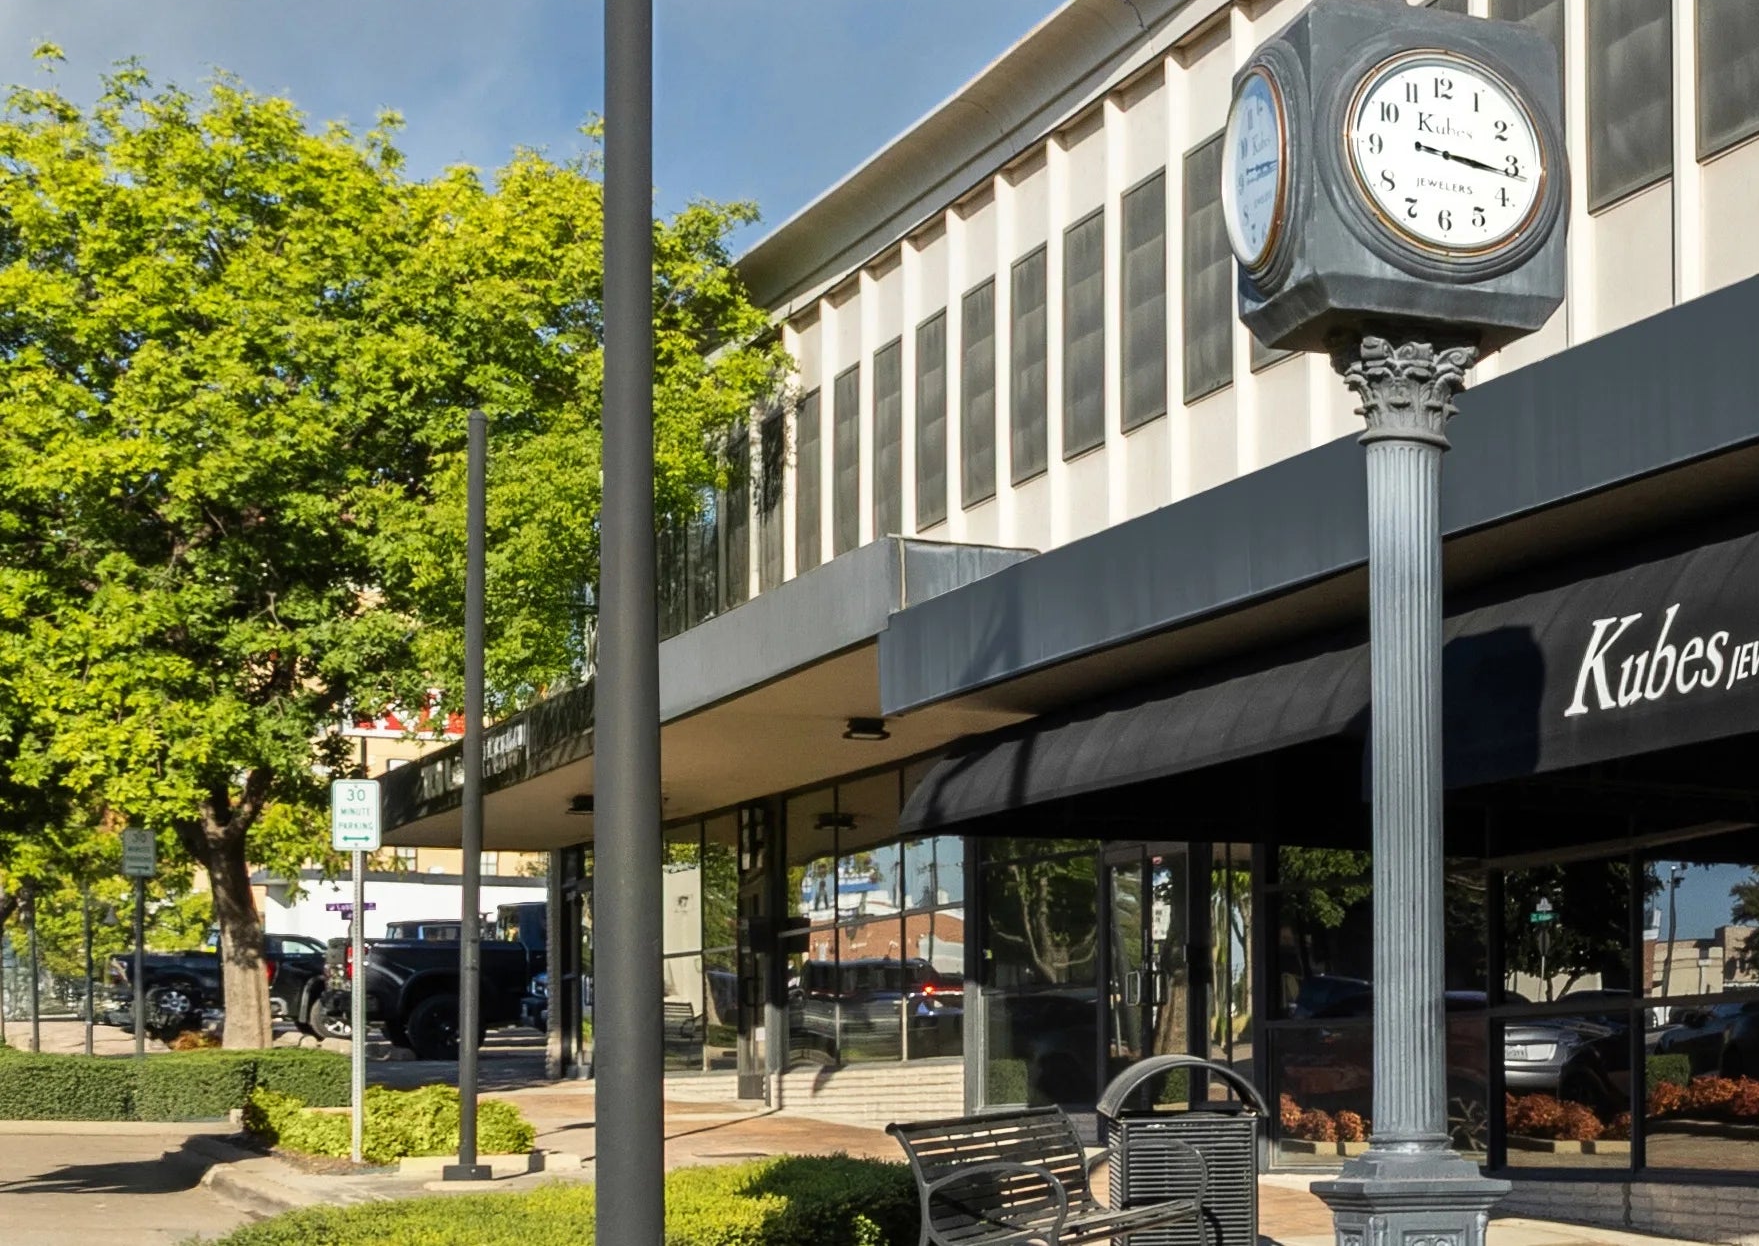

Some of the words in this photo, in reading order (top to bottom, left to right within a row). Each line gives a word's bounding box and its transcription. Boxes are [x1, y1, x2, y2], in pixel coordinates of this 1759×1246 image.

[1405, 81, 1419, 104] 11
[1433, 77, 1454, 100] 12
[1380, 100, 1400, 124] 10
[1473, 91, 1480, 113] 1
[1417, 111, 1474, 141] Kubes
[1494, 119, 1509, 142] 2
[1369, 132, 1384, 155] 9
[1504, 154, 1520, 178] 3
[1379, 168, 1396, 192] 8
[1416, 177, 1474, 196] JEWELERS
[1404, 196, 1419, 219] 7
[1494, 186, 1510, 208] 4
[1437, 208, 1453, 232] 6
[1471, 205, 1486, 228] 5
[1563, 602, 1730, 718] Kubes
[346, 788, 367, 802] 30
[341, 807, 371, 817] MINUTE
[338, 821, 374, 831] PARKING
